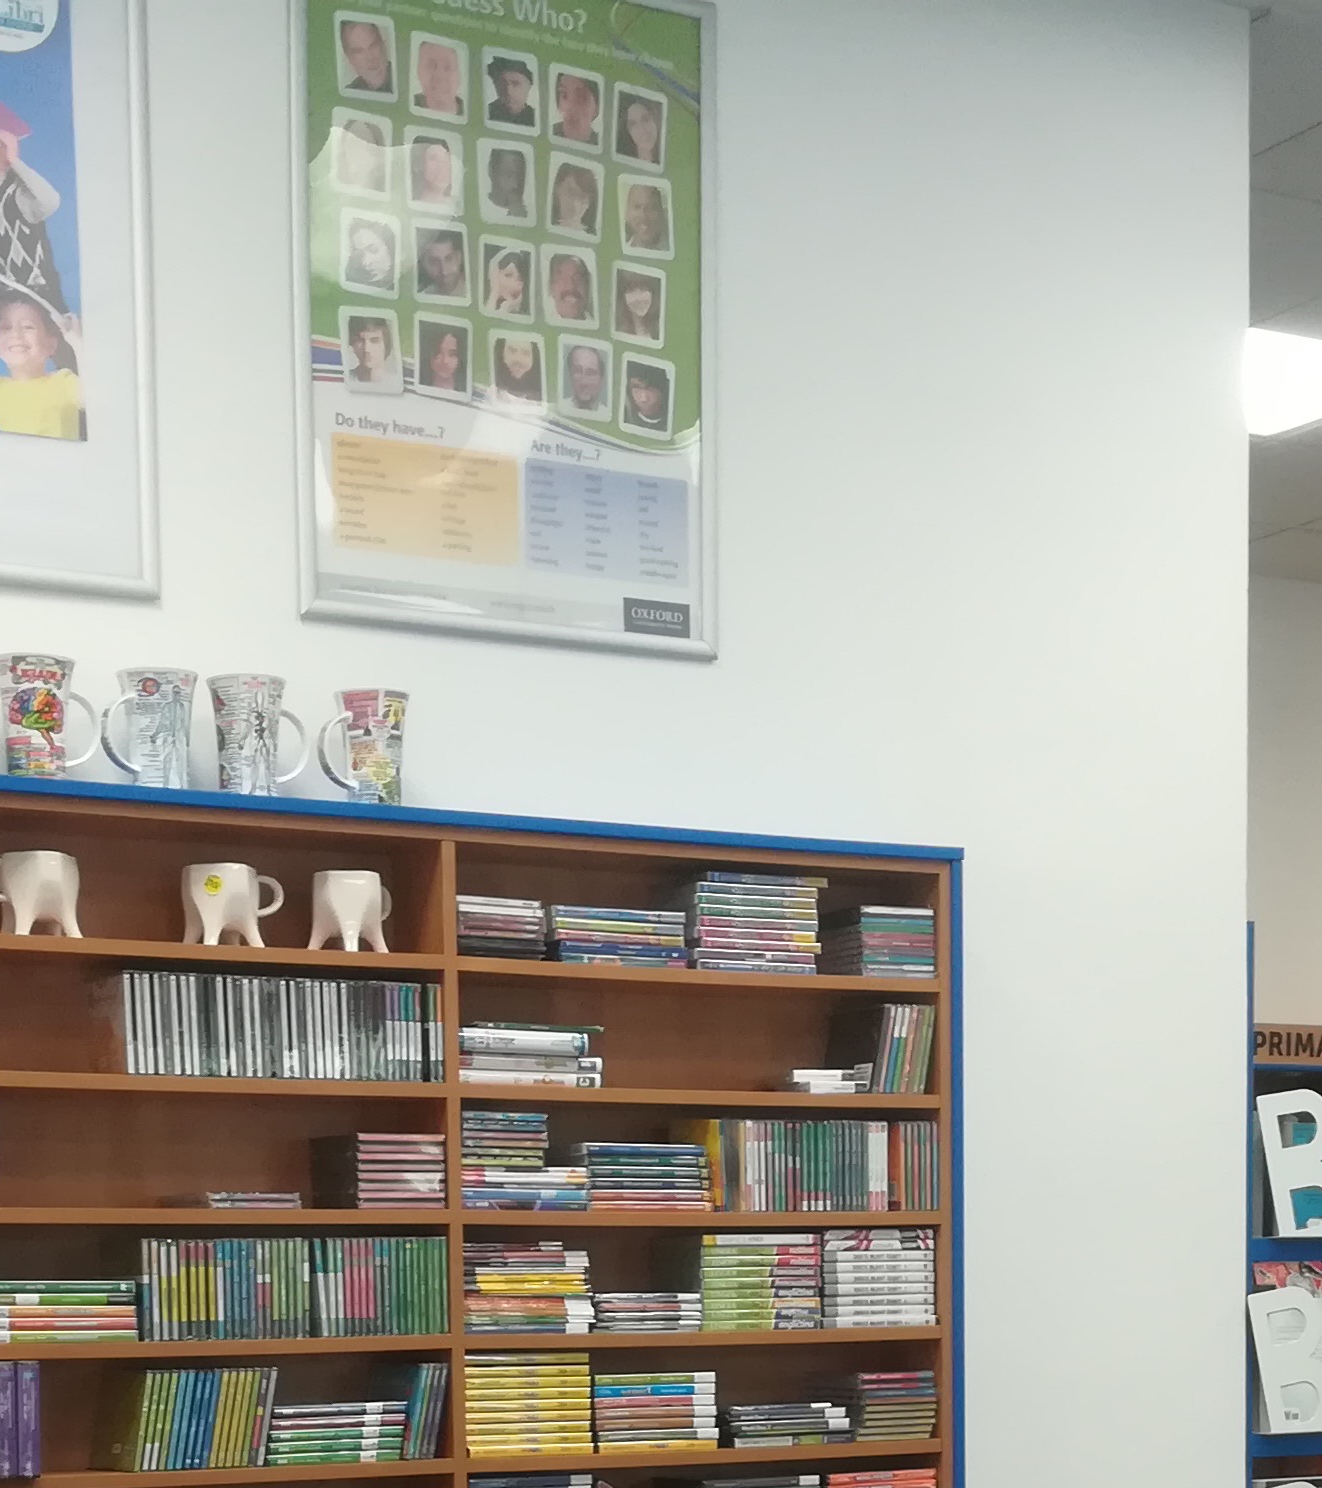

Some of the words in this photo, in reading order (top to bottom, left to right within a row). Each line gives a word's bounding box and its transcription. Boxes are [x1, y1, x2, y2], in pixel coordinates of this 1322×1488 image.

[513, 0, 589, 33] Who?
[334, 412, 355, 428] Do
[358, 416, 390, 435] they
[530, 440, 552, 456] Are
[630, 606, 684, 623] OXFORD
